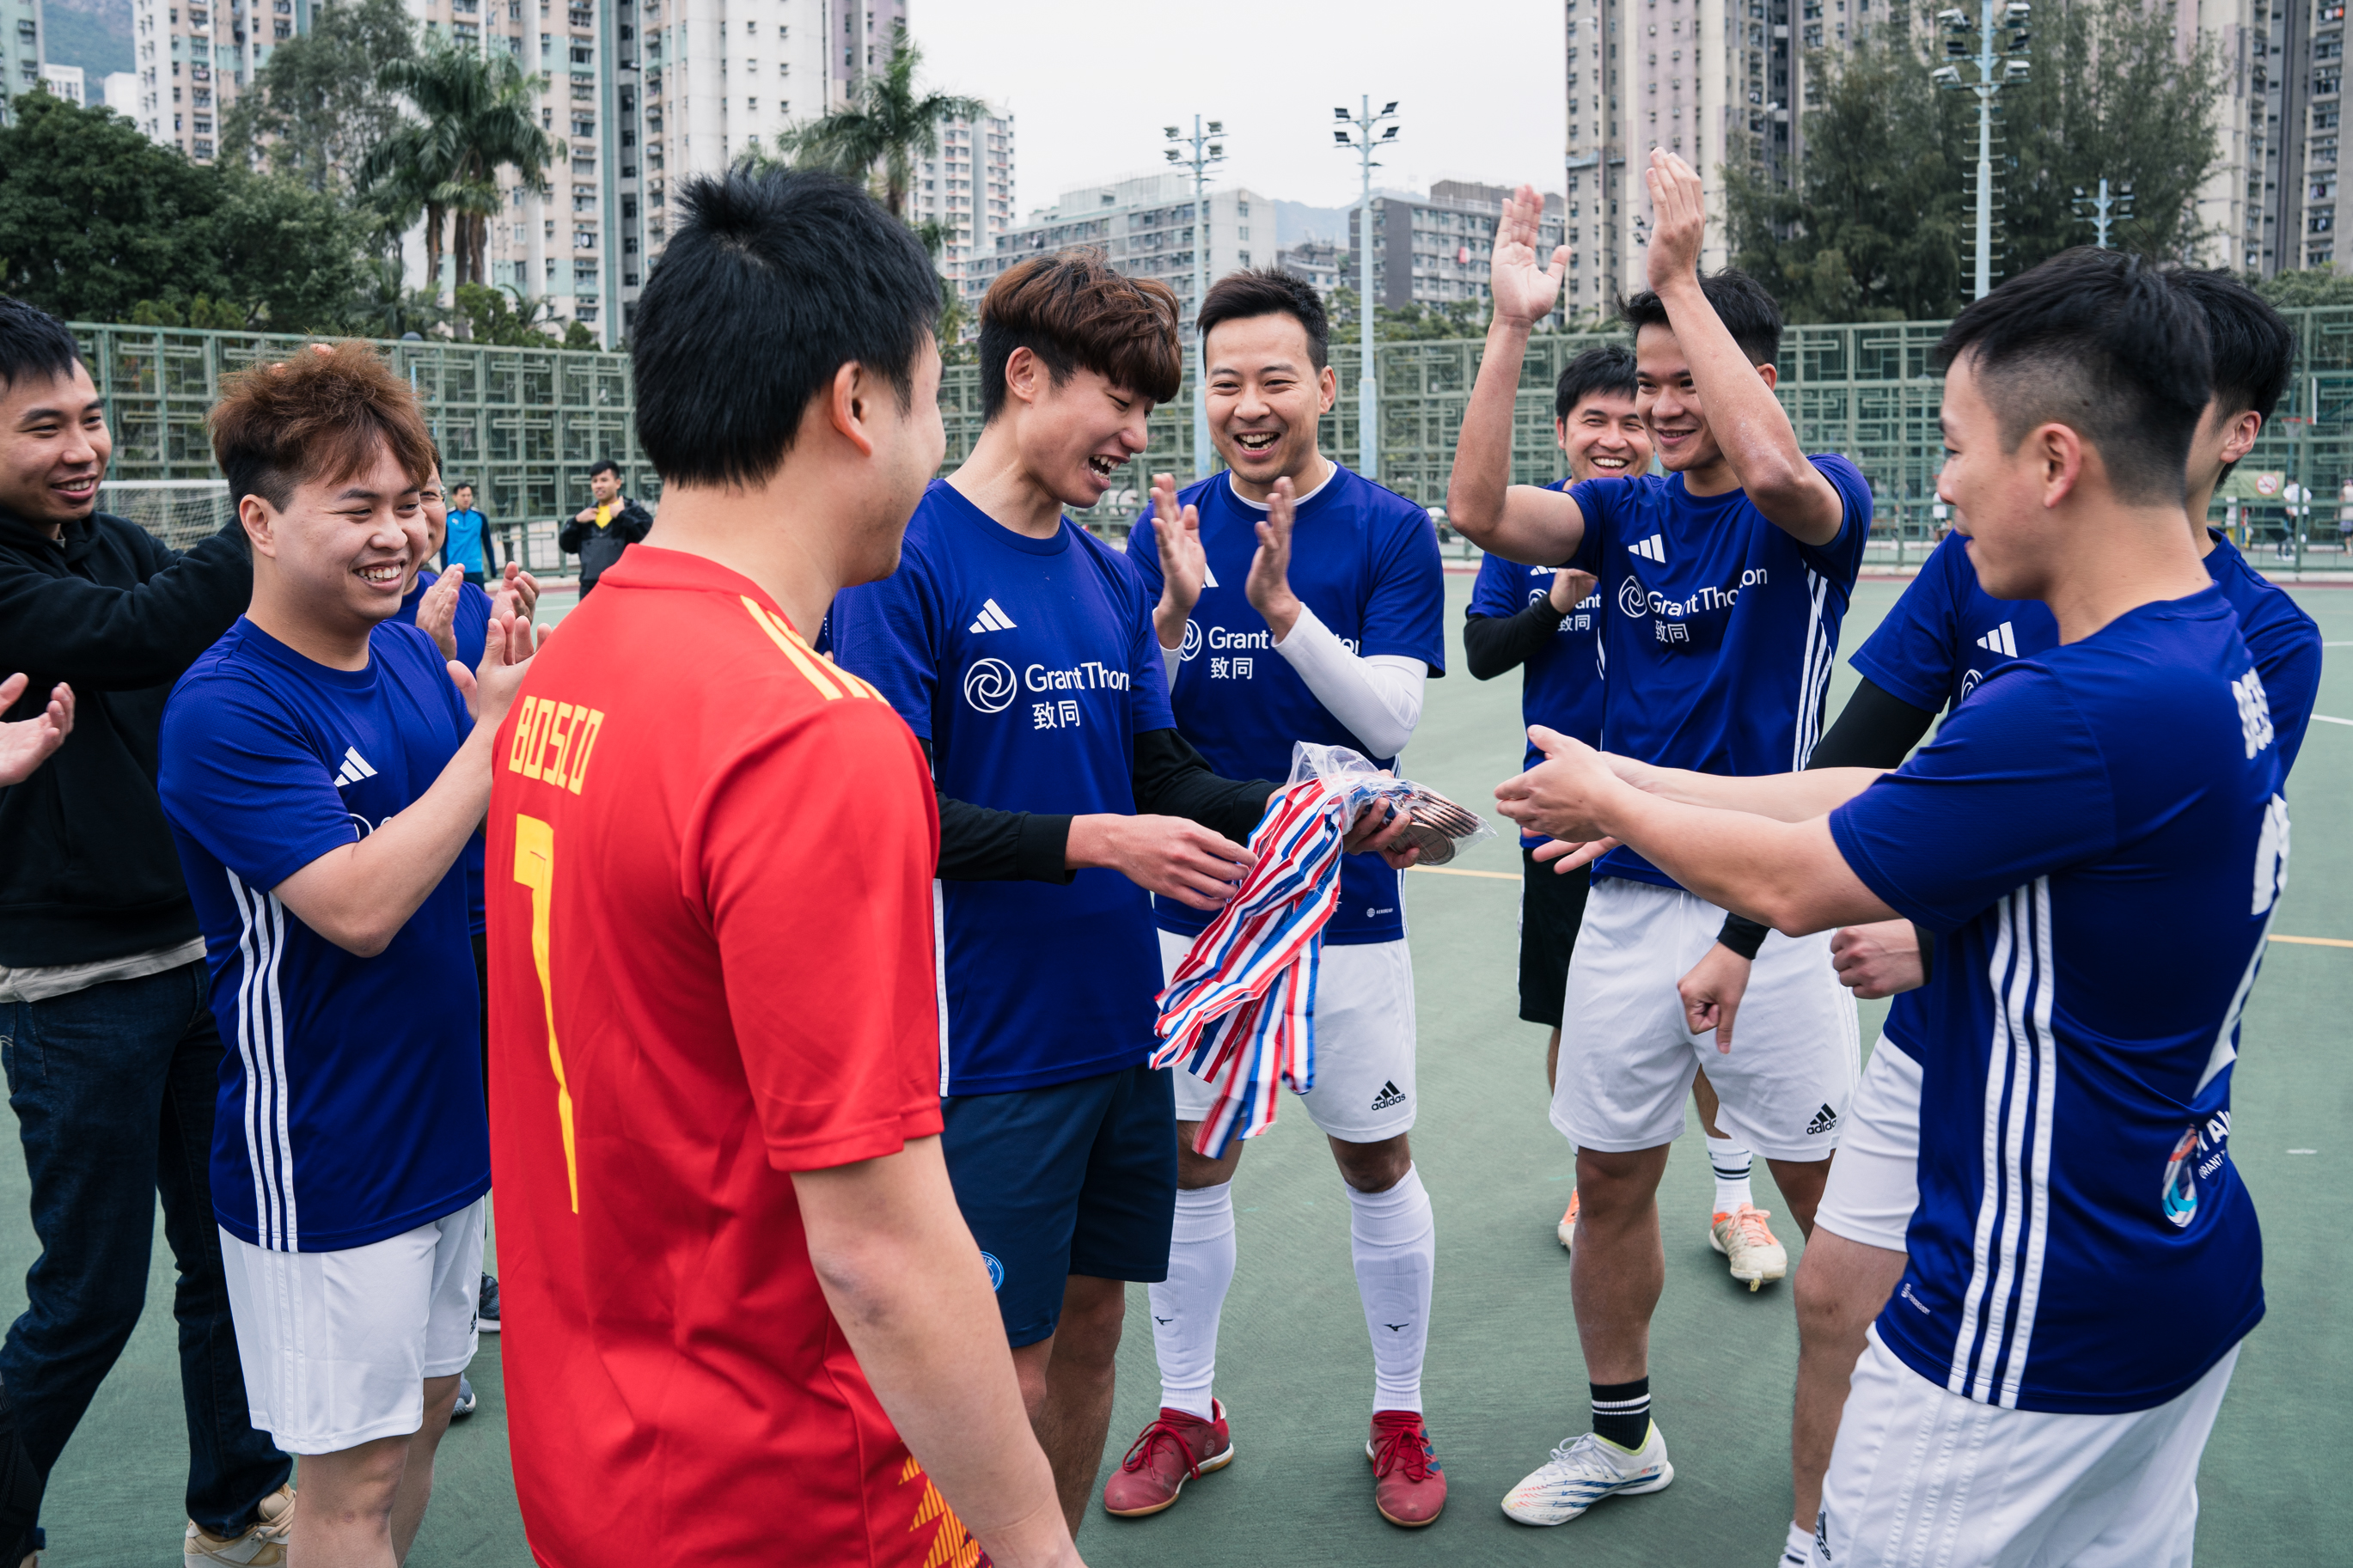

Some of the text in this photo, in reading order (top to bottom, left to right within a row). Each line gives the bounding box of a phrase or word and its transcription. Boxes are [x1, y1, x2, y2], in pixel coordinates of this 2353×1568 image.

[1655, 619, 1690, 644] 致同
[1211, 656, 1253, 680] 致同
[1032, 700, 1080, 729] 致同
[509, 695, 605, 796] BOSCO
[1371, 1093, 1406, 1111] adidas
[1806, 1119, 1837, 1135] adida
